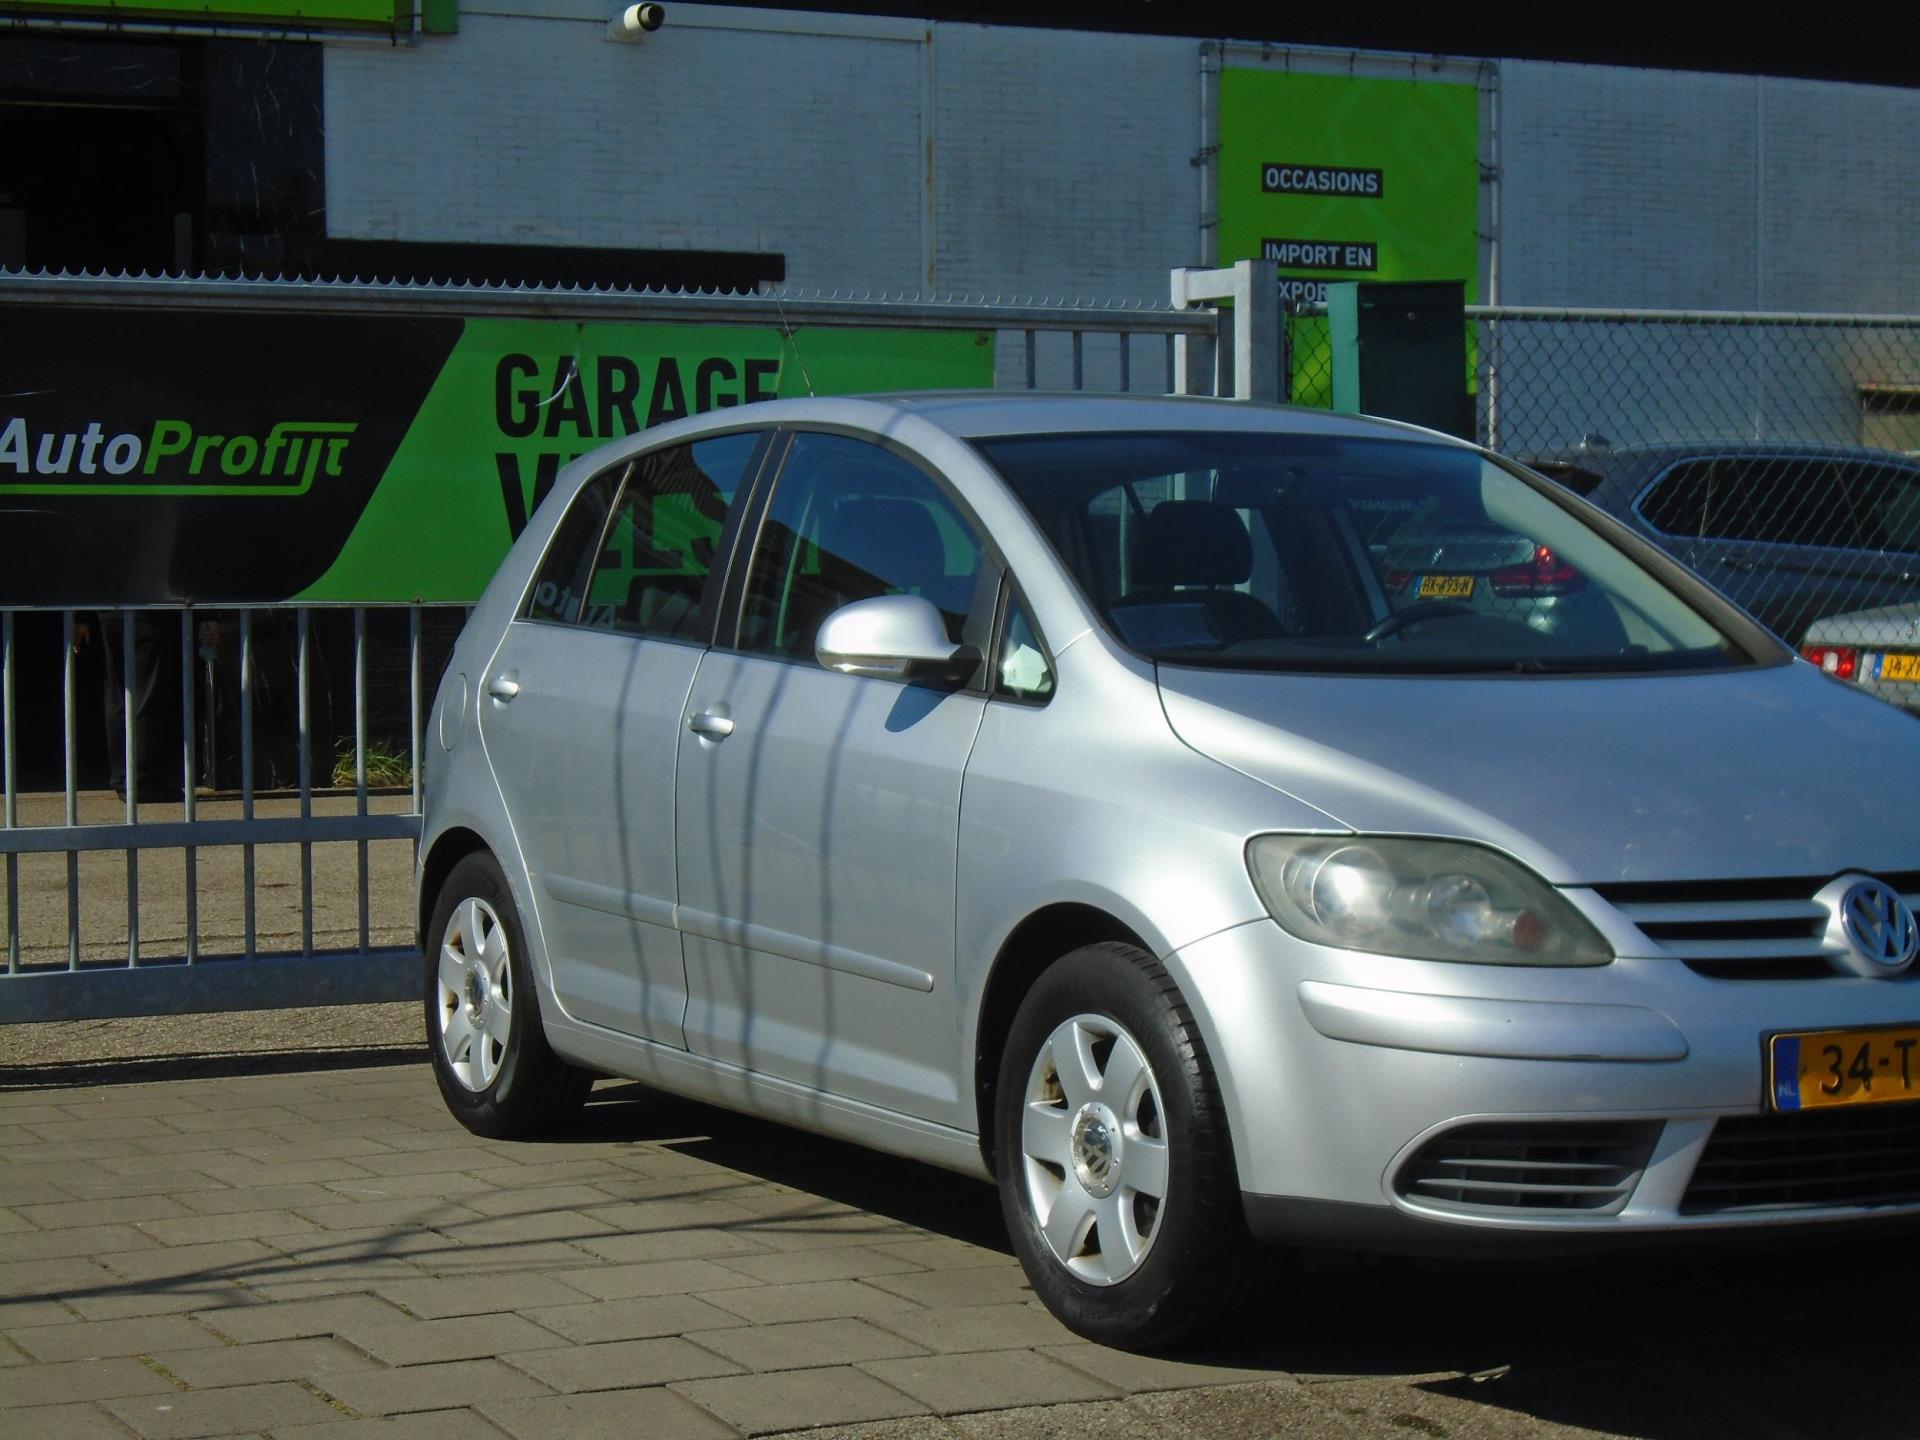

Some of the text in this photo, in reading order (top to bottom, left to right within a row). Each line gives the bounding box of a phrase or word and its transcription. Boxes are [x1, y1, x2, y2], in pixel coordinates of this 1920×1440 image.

[1266, 168, 1378, 193] OCCASIONS
[1265, 243, 1372, 267] IMPORT EN
[1278, 280, 1329, 302] XPOR
[0, 417, 359, 496] AutoProfijt
[1820, 1039, 1916, 1095] 34-T
